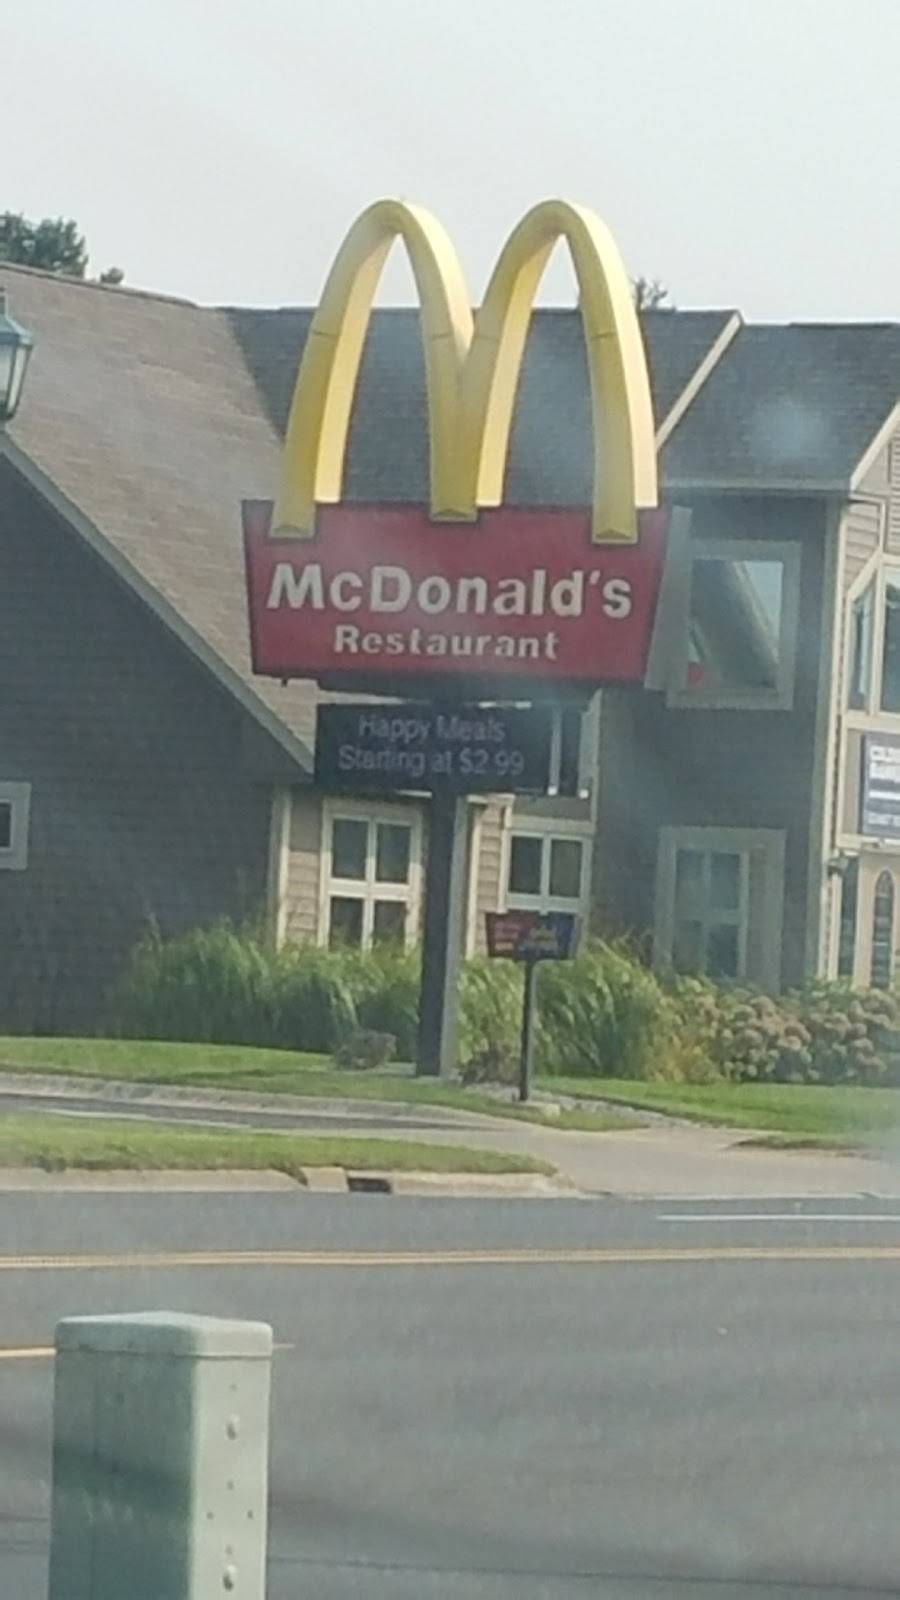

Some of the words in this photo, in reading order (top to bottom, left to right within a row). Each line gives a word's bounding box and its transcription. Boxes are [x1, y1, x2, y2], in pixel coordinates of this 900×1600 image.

[266, 563, 633, 619] McDonald's
[334, 625, 560, 660] Restaurant
[358, 714, 431, 744] Happy
[436, 714, 505, 743] Meals
[338, 744, 426, 777] Starting
[431, 751, 453, 774] at
[460, 749, 525, 776] $299
